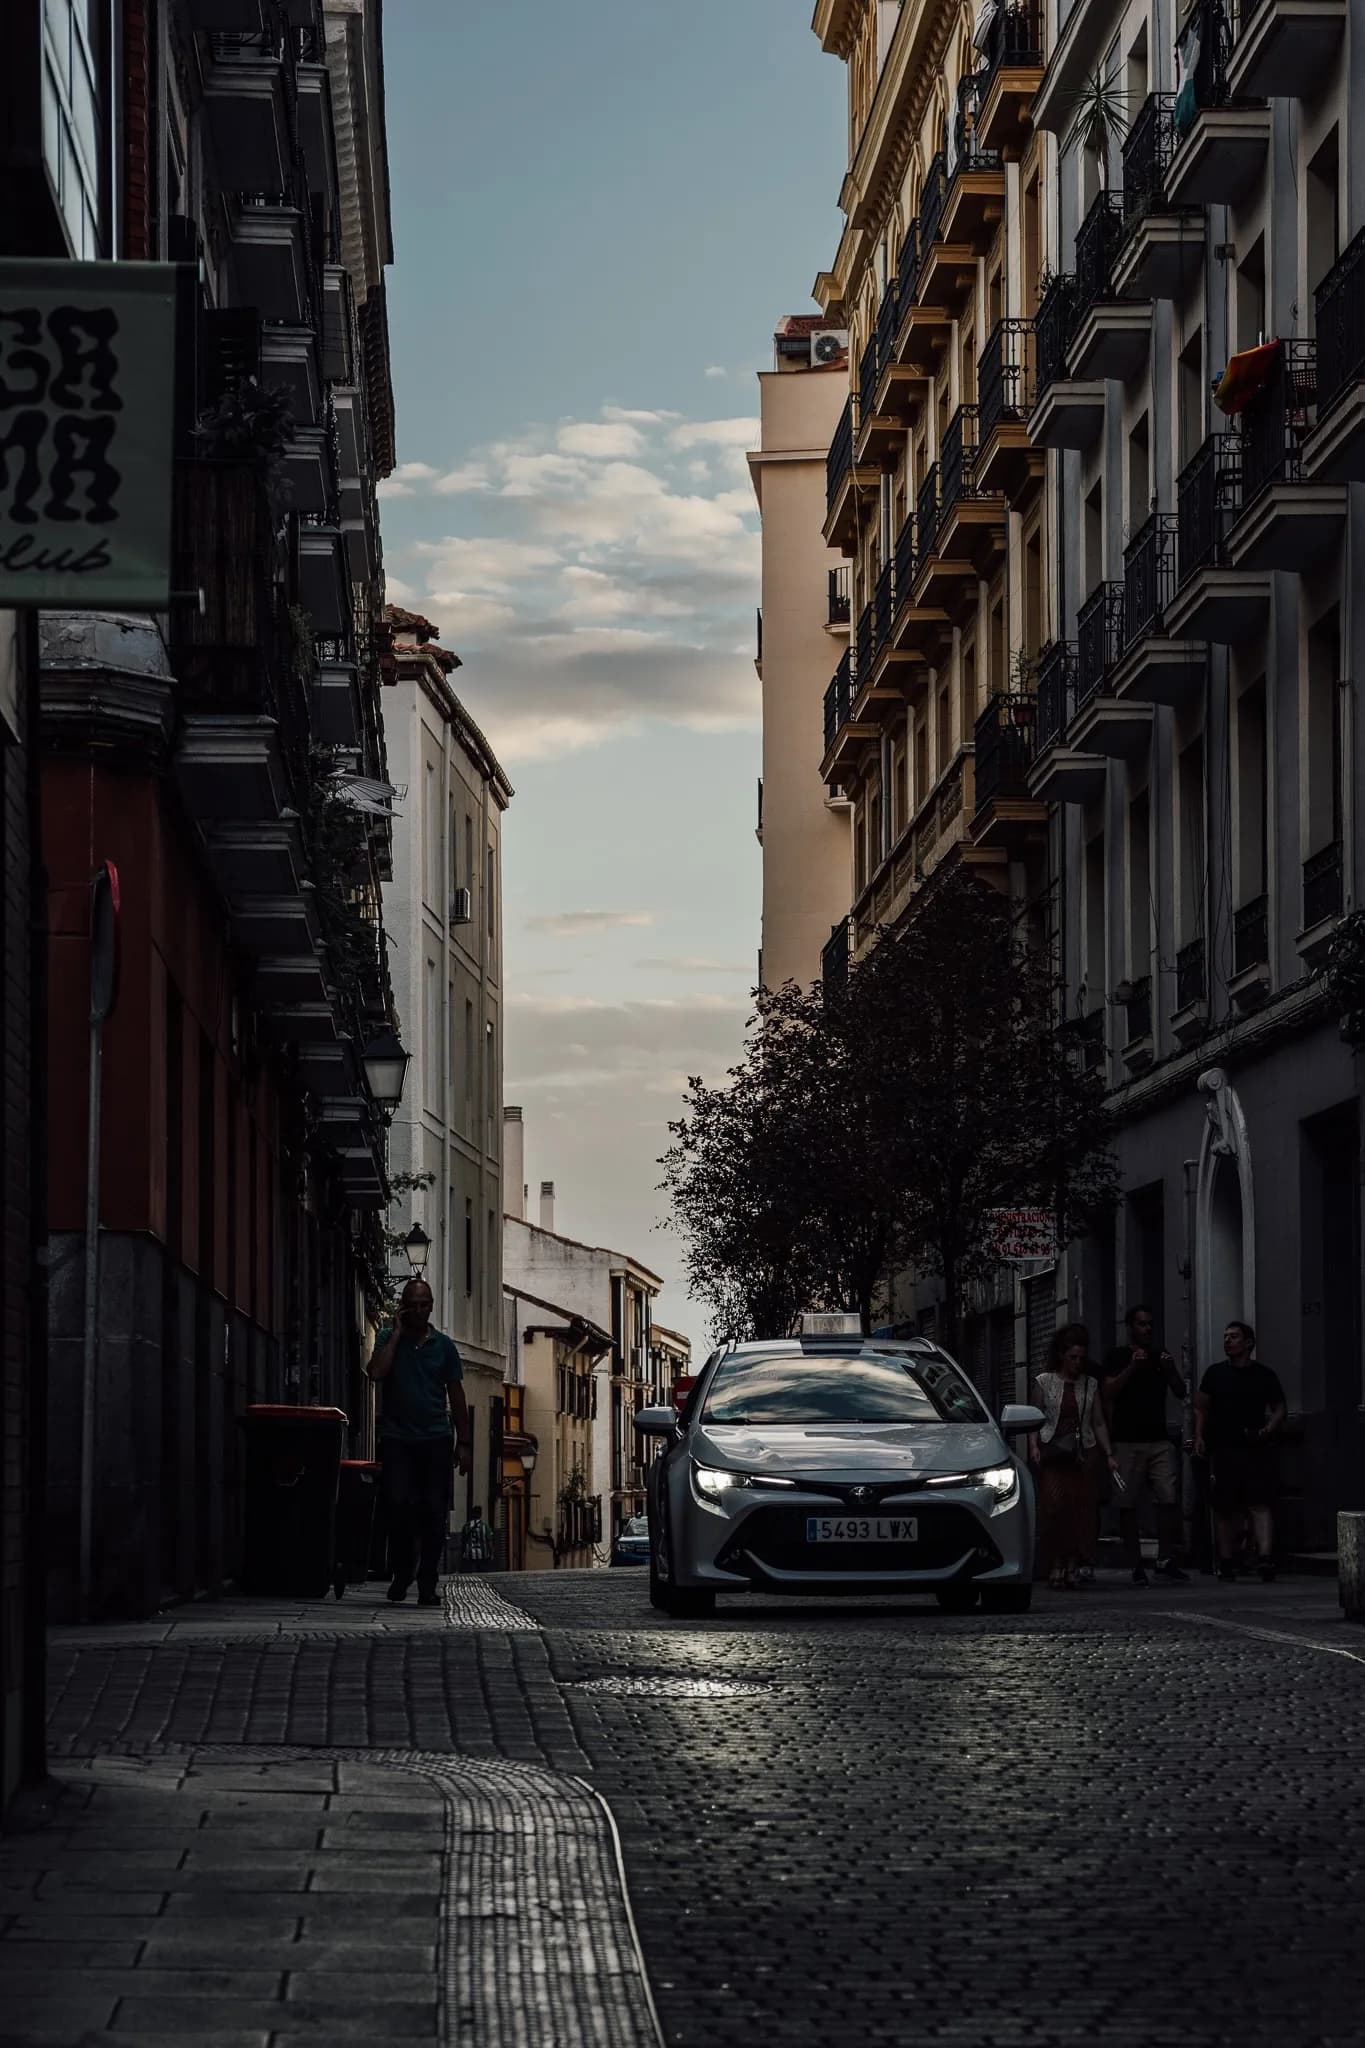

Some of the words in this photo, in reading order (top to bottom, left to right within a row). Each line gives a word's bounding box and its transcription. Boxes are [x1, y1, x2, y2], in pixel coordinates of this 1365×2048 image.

[0, 533, 112, 572] lub
[821, 1521, 869, 1539] 5493
[877, 1521, 913, 1539] LWX
